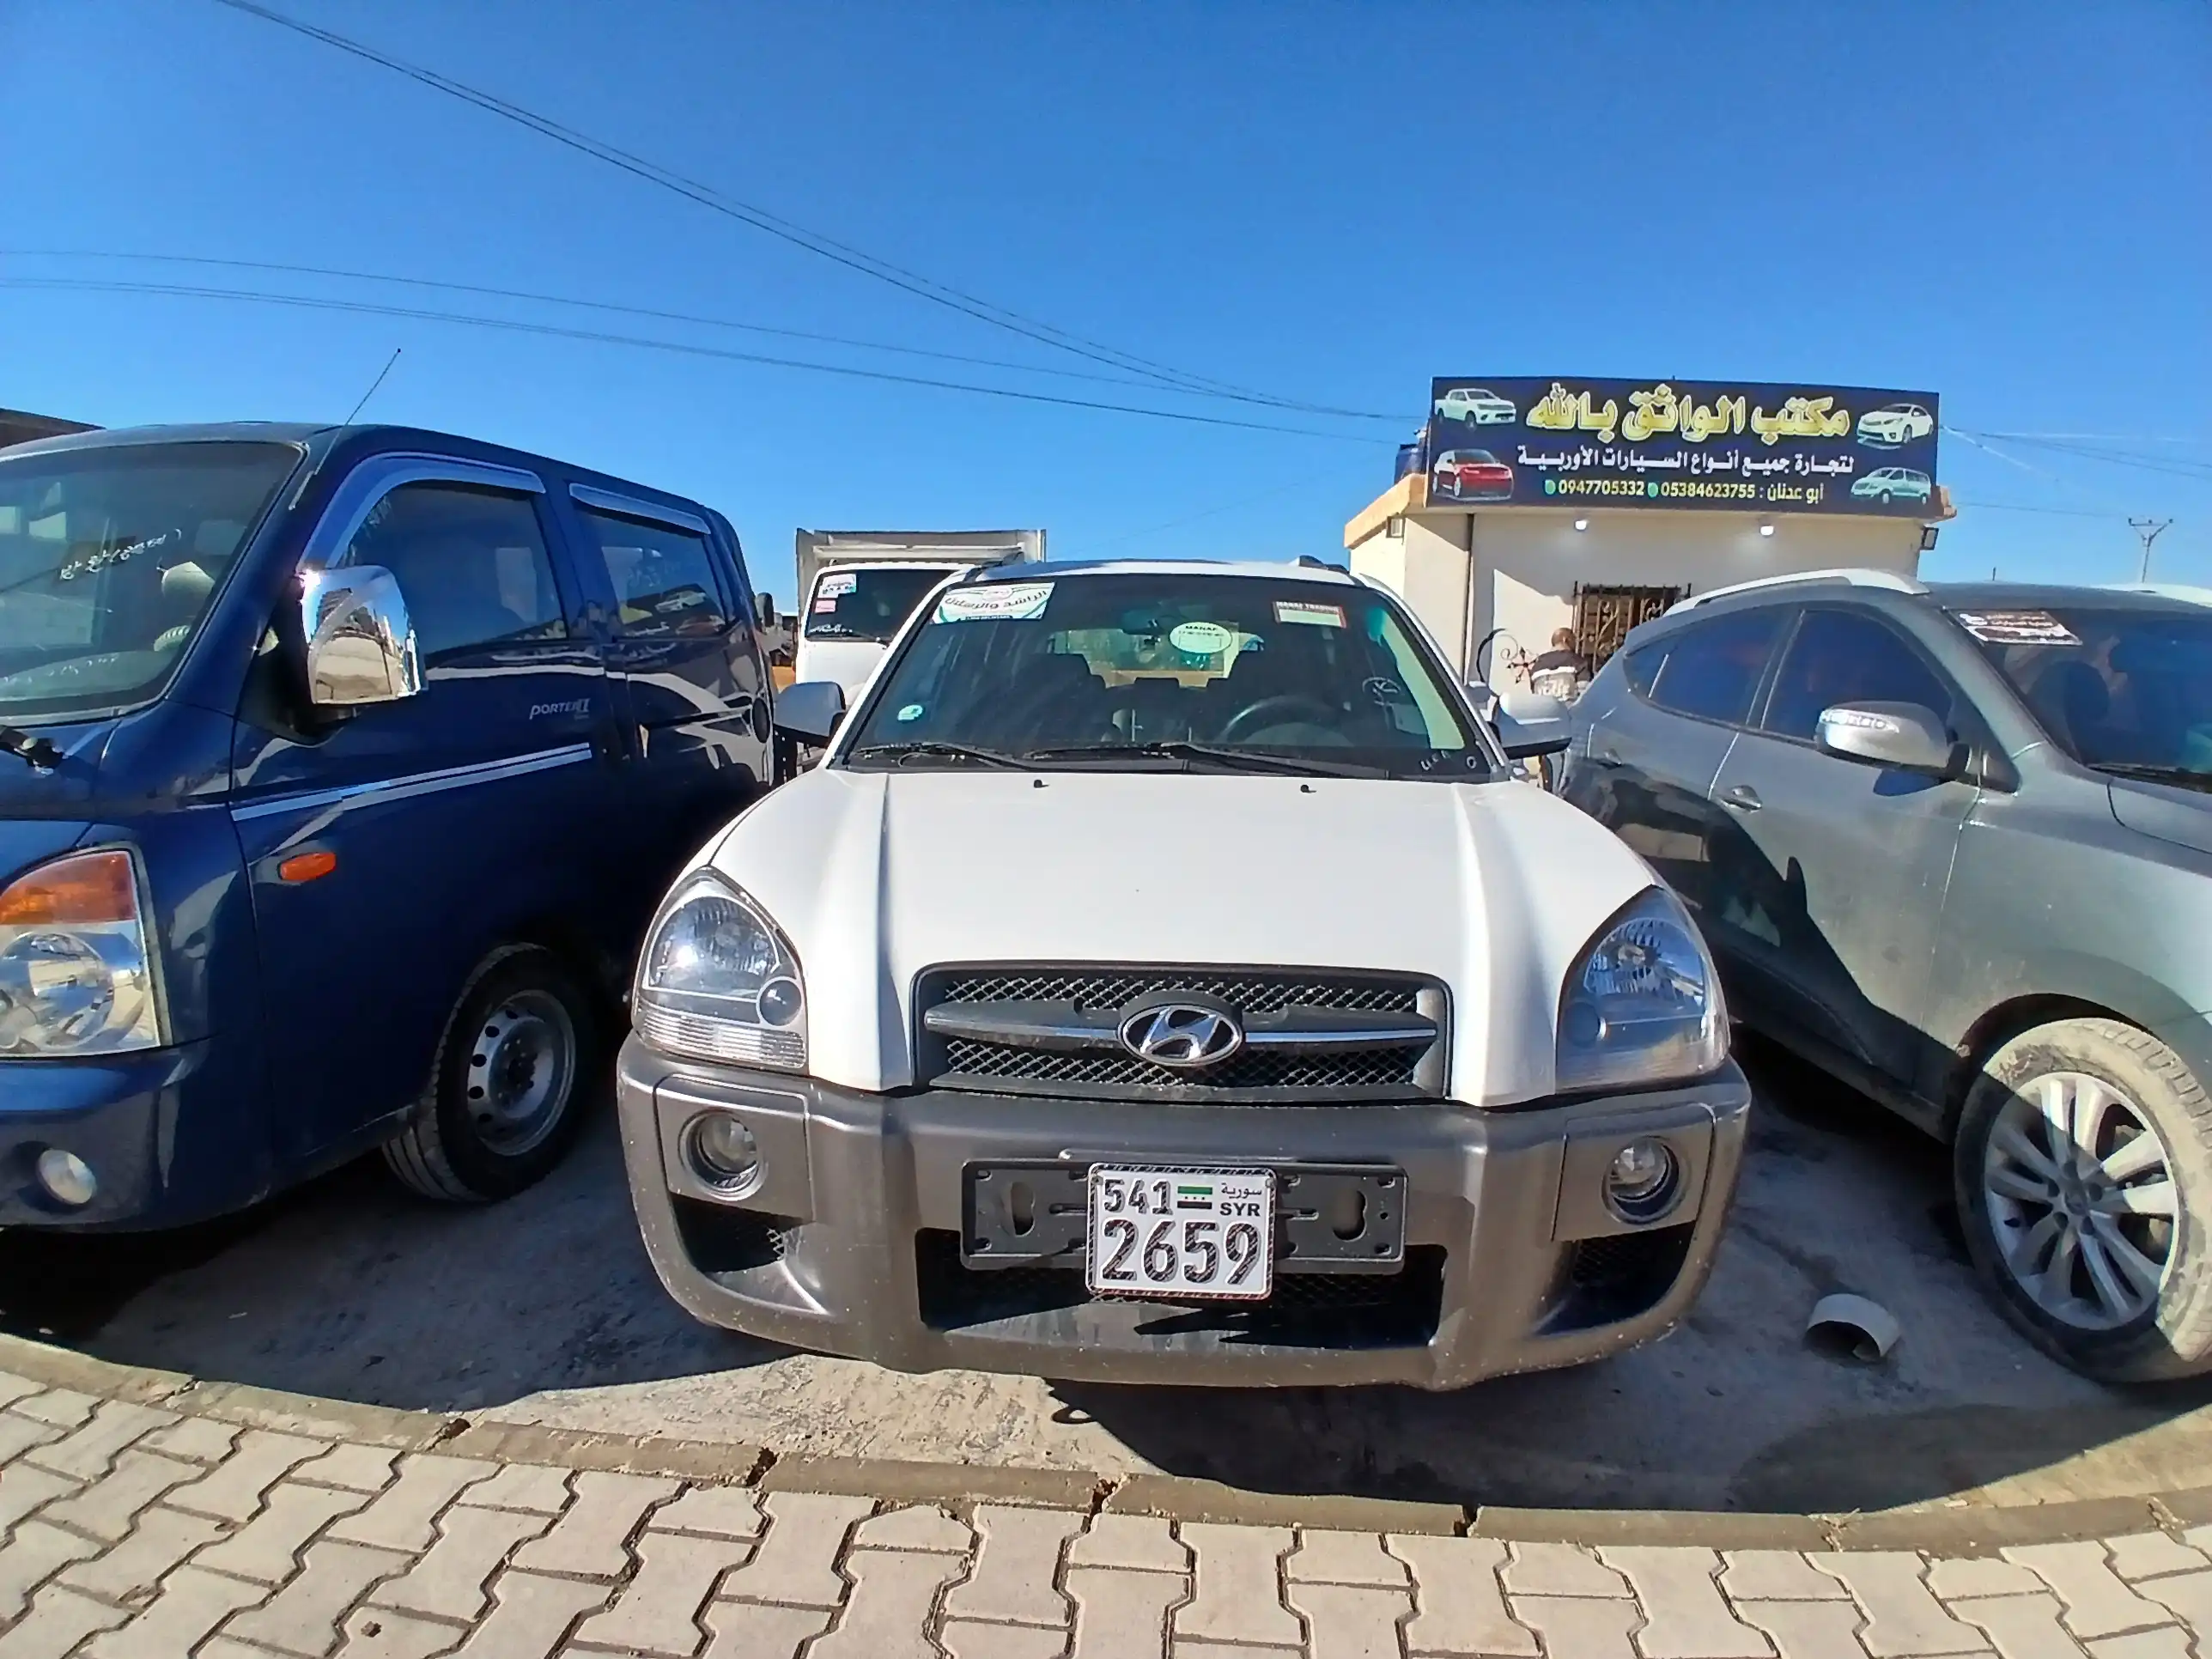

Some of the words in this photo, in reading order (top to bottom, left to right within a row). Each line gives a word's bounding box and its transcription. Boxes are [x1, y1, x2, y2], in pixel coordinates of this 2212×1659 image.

[1526, 382, 1618, 443] بالله
[1622, 383, 1746, 442] الواثق
[1751, 397, 1850, 445] مكتب
[1517, 444, 1598, 471] الأوربية
[1602, 447, 1687, 472] السيارات
[1691, 448, 1738, 474] أنواع
[1741, 456, 1790, 477] جميع
[1796, 453, 1854, 477] لتجارة
[1559, 479, 1644, 495] 0947705332
[1661, 481, 1755, 499] 05384623755
[1767, 482, 1802, 501] عدنان
[1103, 1178, 1174, 1215] 541
[1220, 1182, 1262, 1200] سورية
[1219, 1202, 1261, 1217] SYR
[1102, 1218, 1261, 1285] 2659
